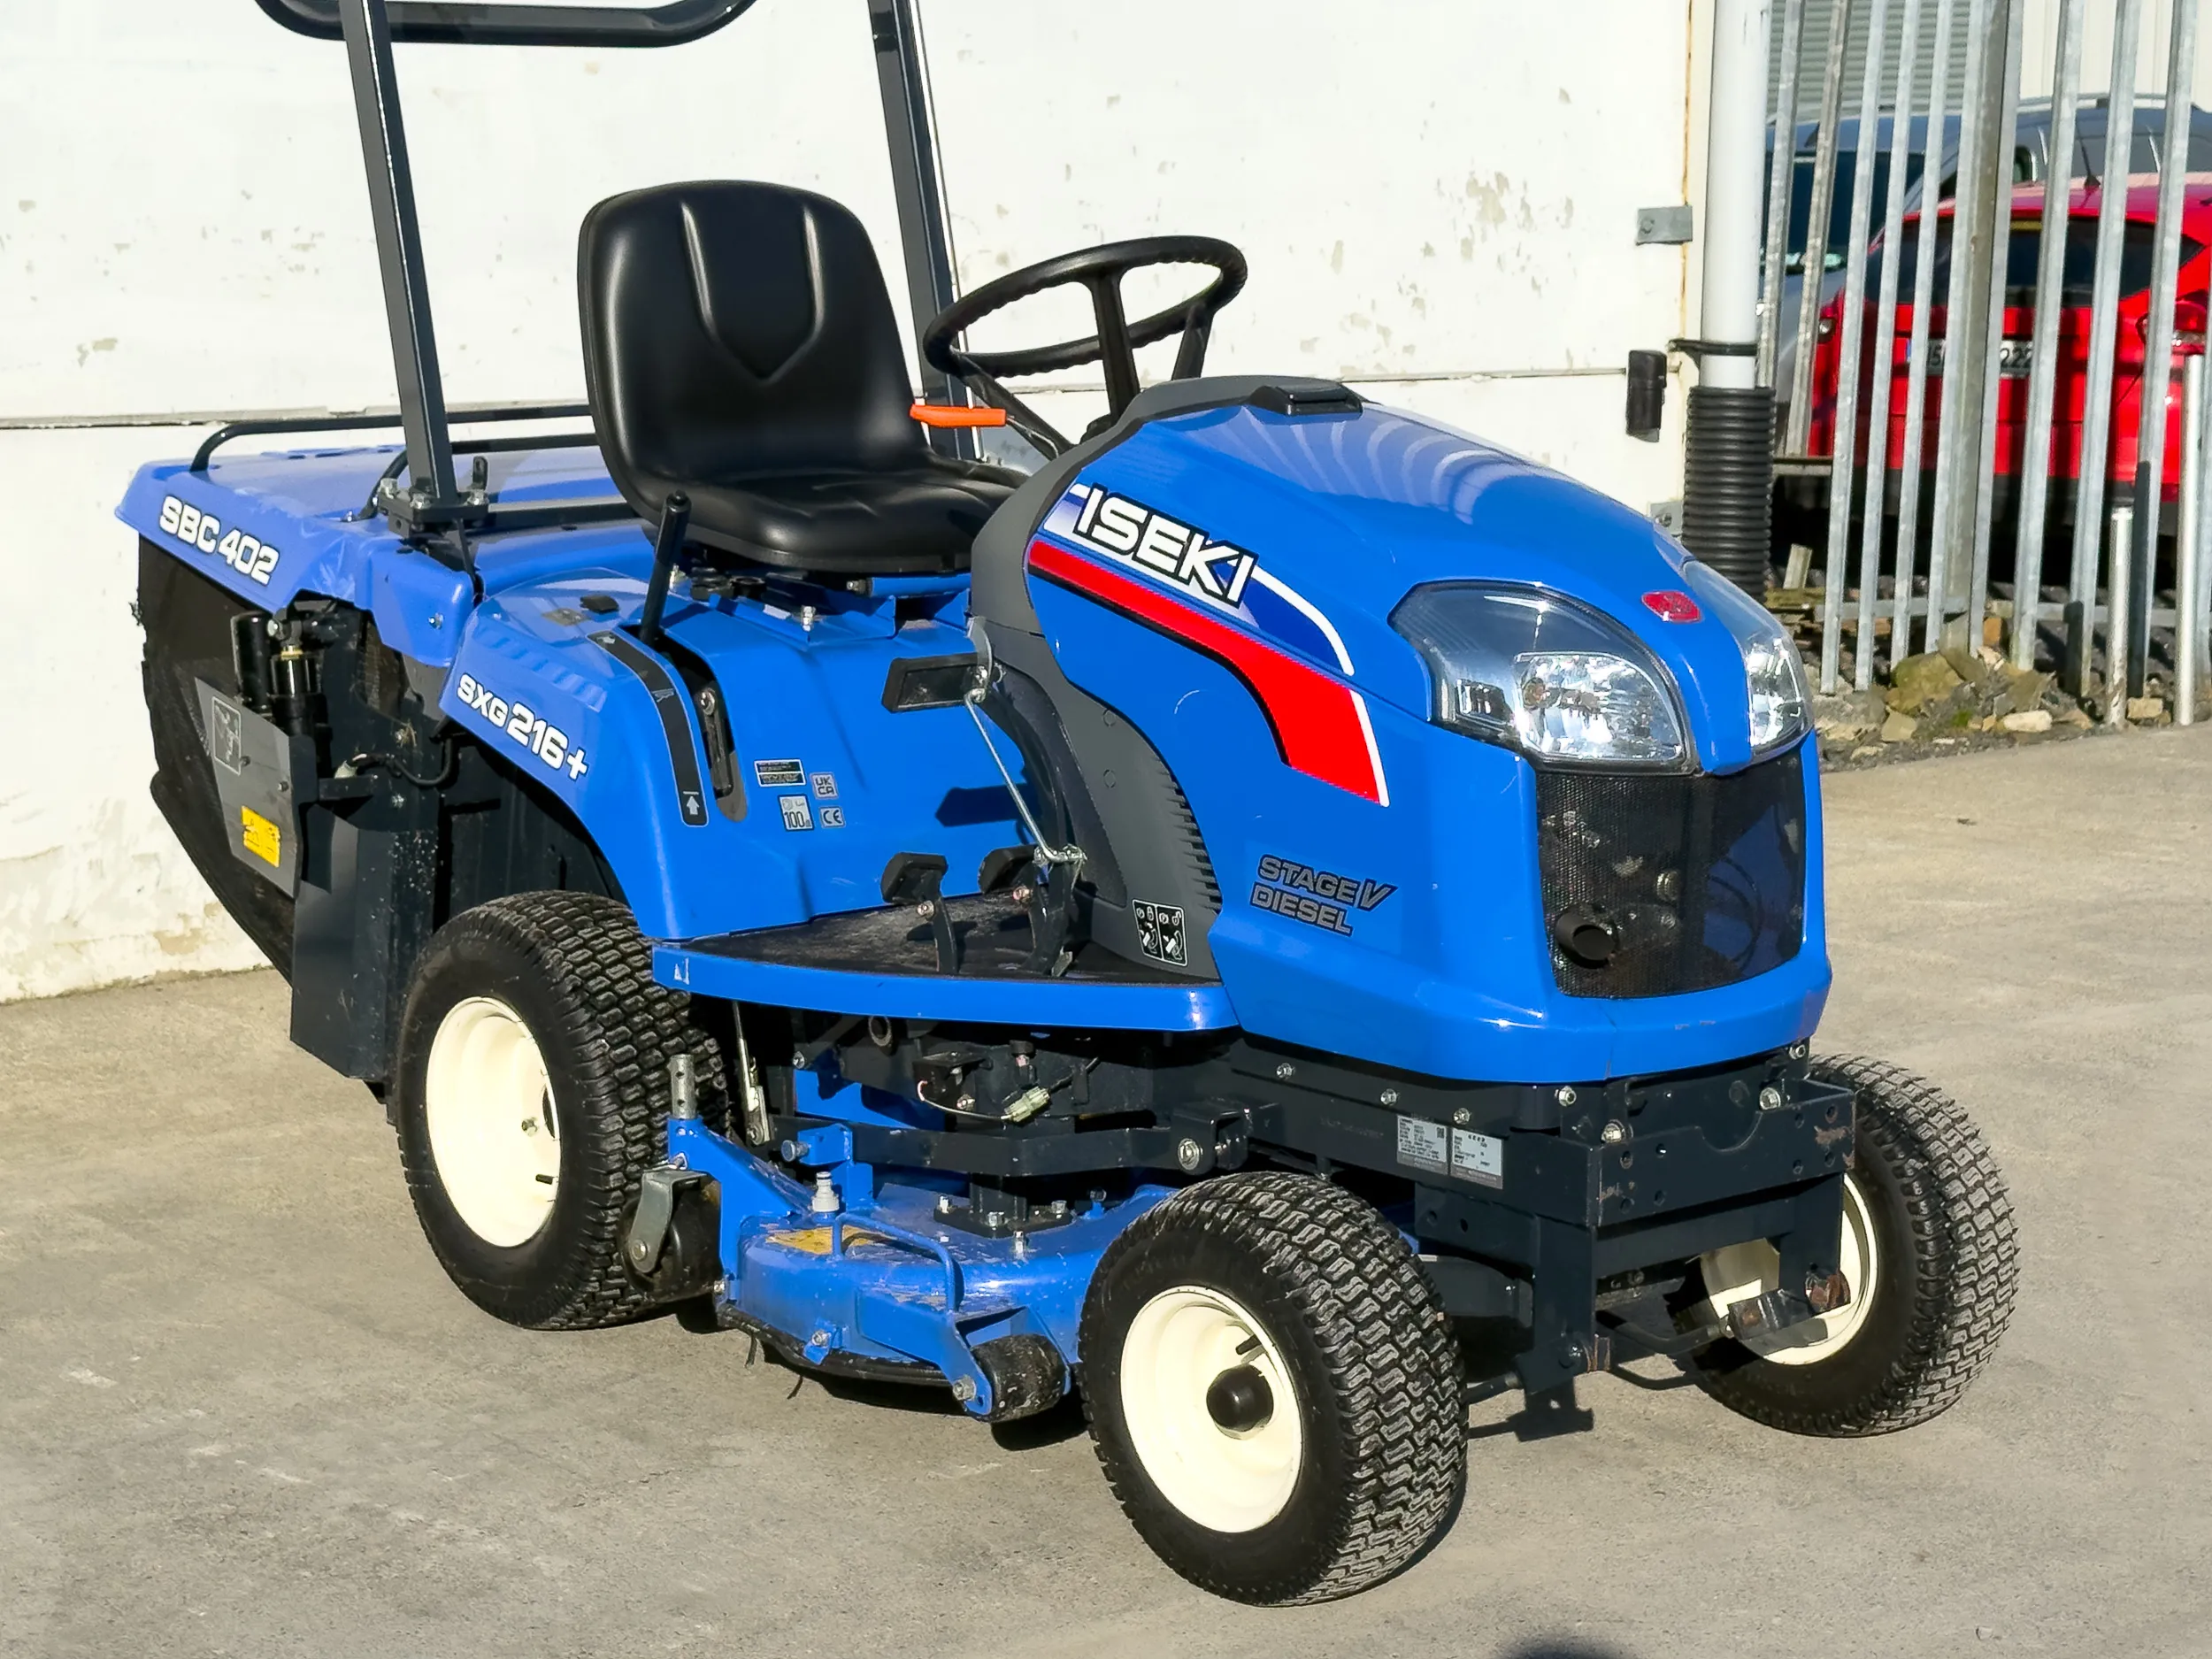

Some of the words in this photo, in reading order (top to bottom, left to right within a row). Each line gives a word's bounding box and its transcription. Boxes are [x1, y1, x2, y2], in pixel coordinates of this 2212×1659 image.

[1075, 485, 1256, 606] ISEKI
[815, 776, 832, 786] UK
[818, 786, 835, 795] CA
[784, 810, 805, 828] 100
[823, 810, 842, 824] CE
[1258, 855, 1360, 905] STAGE
[1358, 879, 1396, 911] V
[1250, 882, 1353, 936] DIESEL
